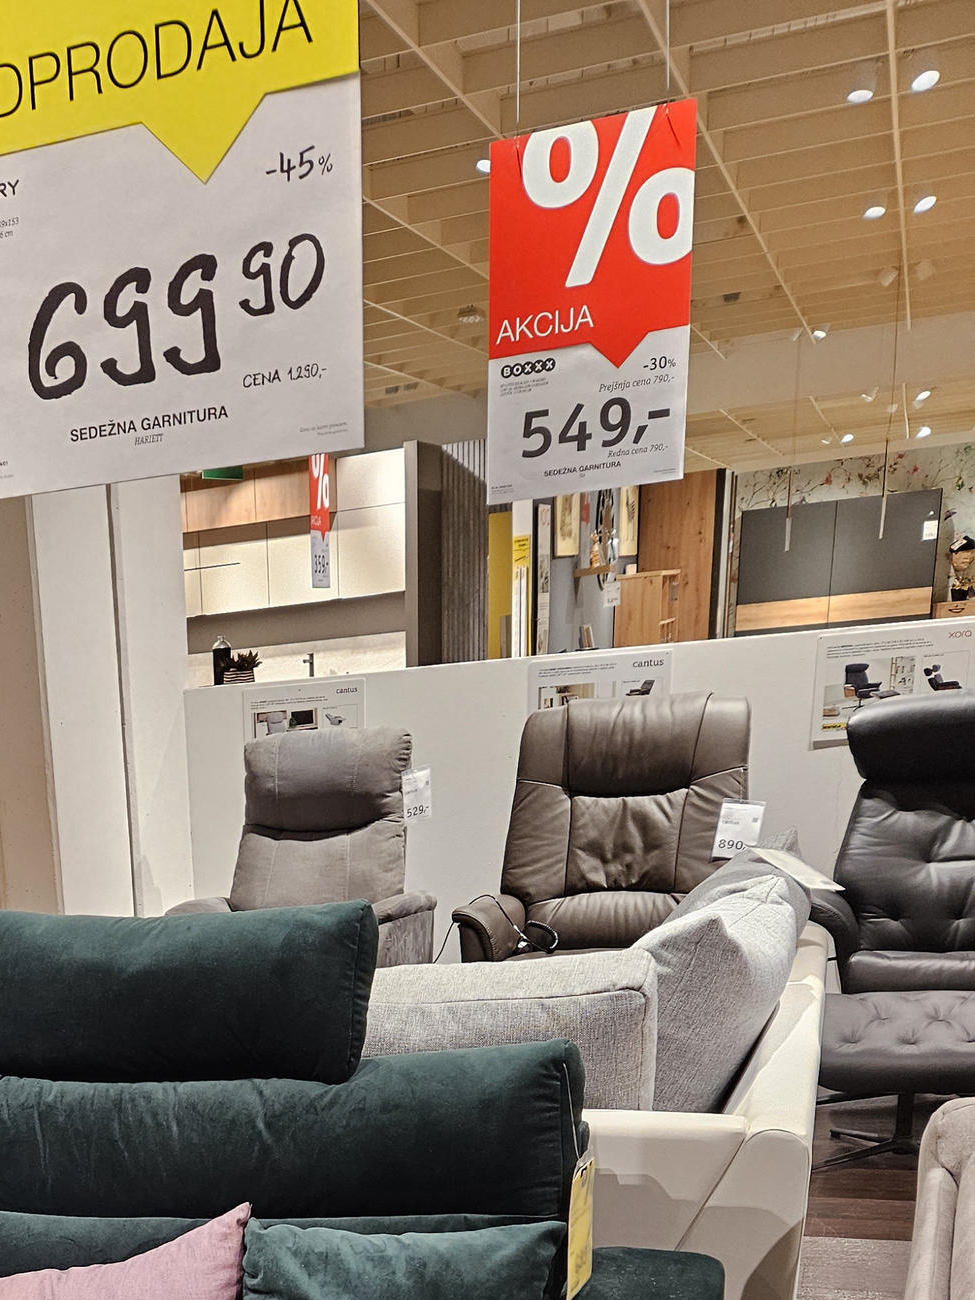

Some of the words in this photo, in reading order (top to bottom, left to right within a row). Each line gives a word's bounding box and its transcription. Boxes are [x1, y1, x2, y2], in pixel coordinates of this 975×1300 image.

[265, 146, 334, 182] -45%
[28, 254, 222, 400] 699
[239, 233, 326, 316] 90
[496, 305, 594, 345] AKCIJA
[502, 358, 555, 378] BOXXX
[643, 356, 677, 371] -30%
[243, 369, 281, 388] CENA
[599, 379, 631, 393] Prejšnja
[632, 378, 651, 388] cena
[653, 374, 675, 385] 790,-
[70, 419, 137, 442] SEDEŽNA
[140, 405, 228, 431] GARNITURA
[521, 397, 670, 458] 549,-
[608, 448, 630, 458] Redna
[631, 446, 648, 456] cena
[649, 443, 669, 453] 790,-
[544, 466, 577, 477] SEDEŽNA
[579, 461, 621, 473] GARNITURA
[948, 630, 972, 639] xora
[632, 659, 664, 668] cantus
[336, 687, 358, 695] cantus
[407, 804, 429, 818] 529,-
